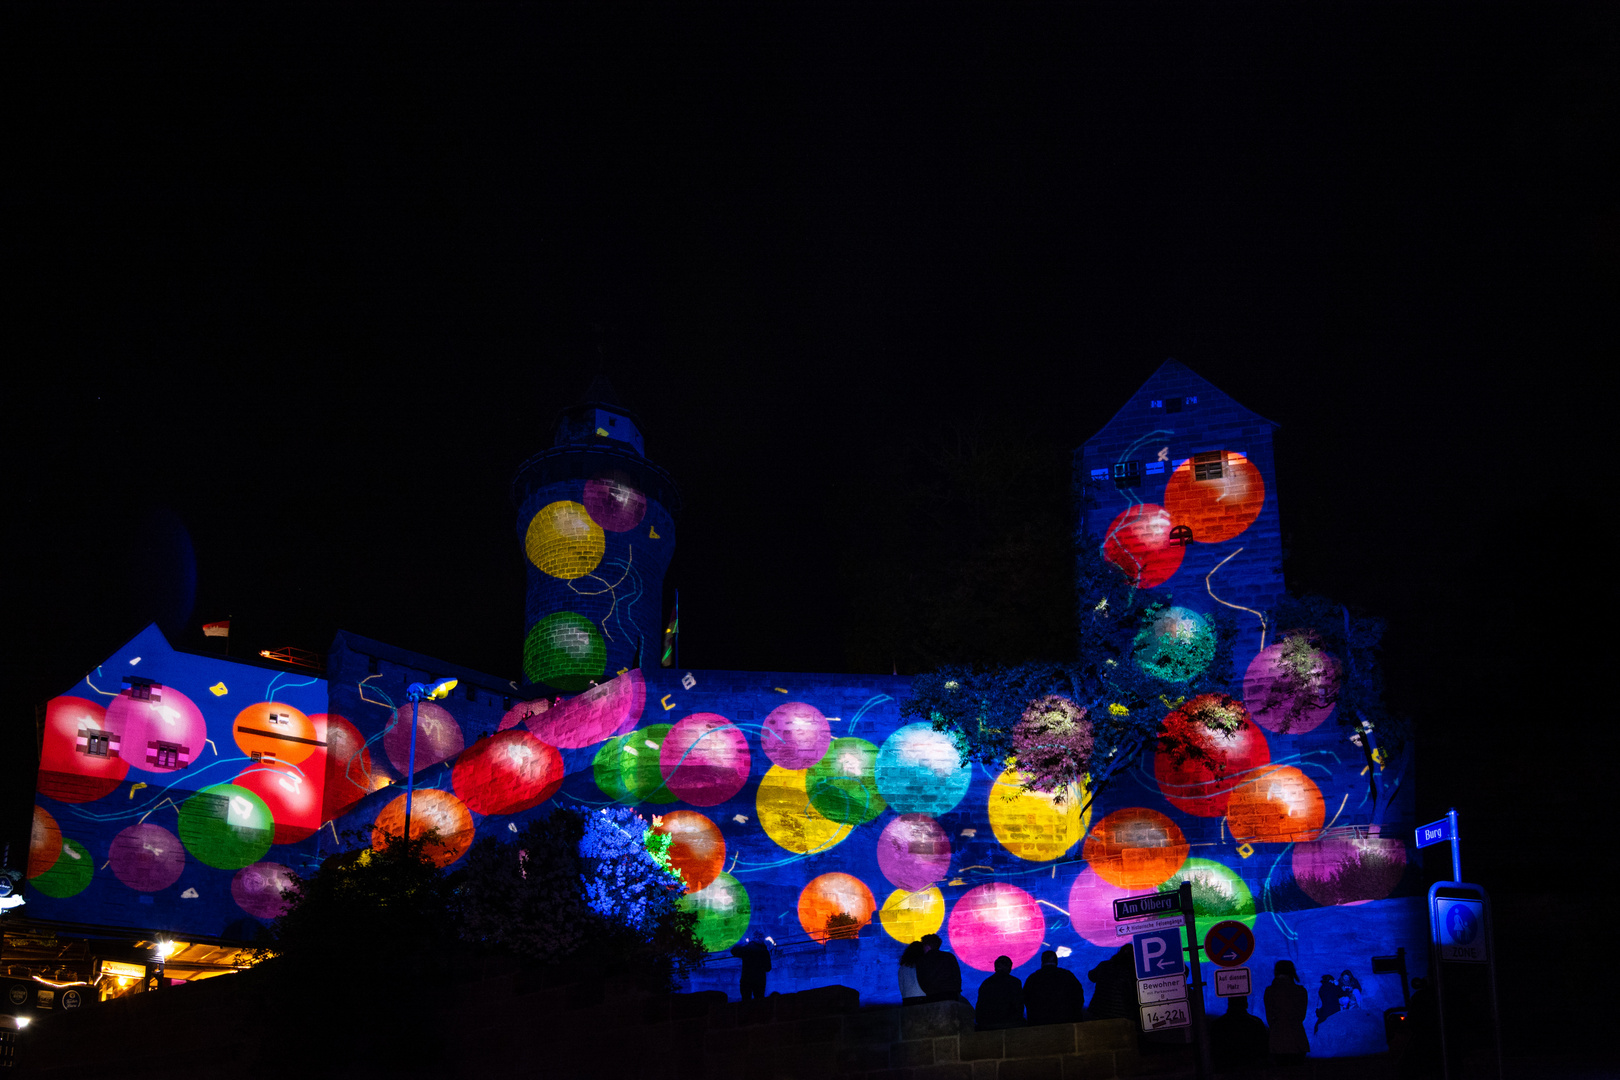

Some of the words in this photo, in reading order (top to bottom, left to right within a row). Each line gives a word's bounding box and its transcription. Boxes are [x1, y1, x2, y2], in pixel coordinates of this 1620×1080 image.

[1425, 828, 1442, 841] Burg
[1122, 903, 1138, 915] Am
[1140, 898, 1172, 911] Ölberg
[1141, 937, 1167, 972] P
[1452, 947, 1477, 958] ZONE
[1143, 980, 1180, 990] Bewohner
